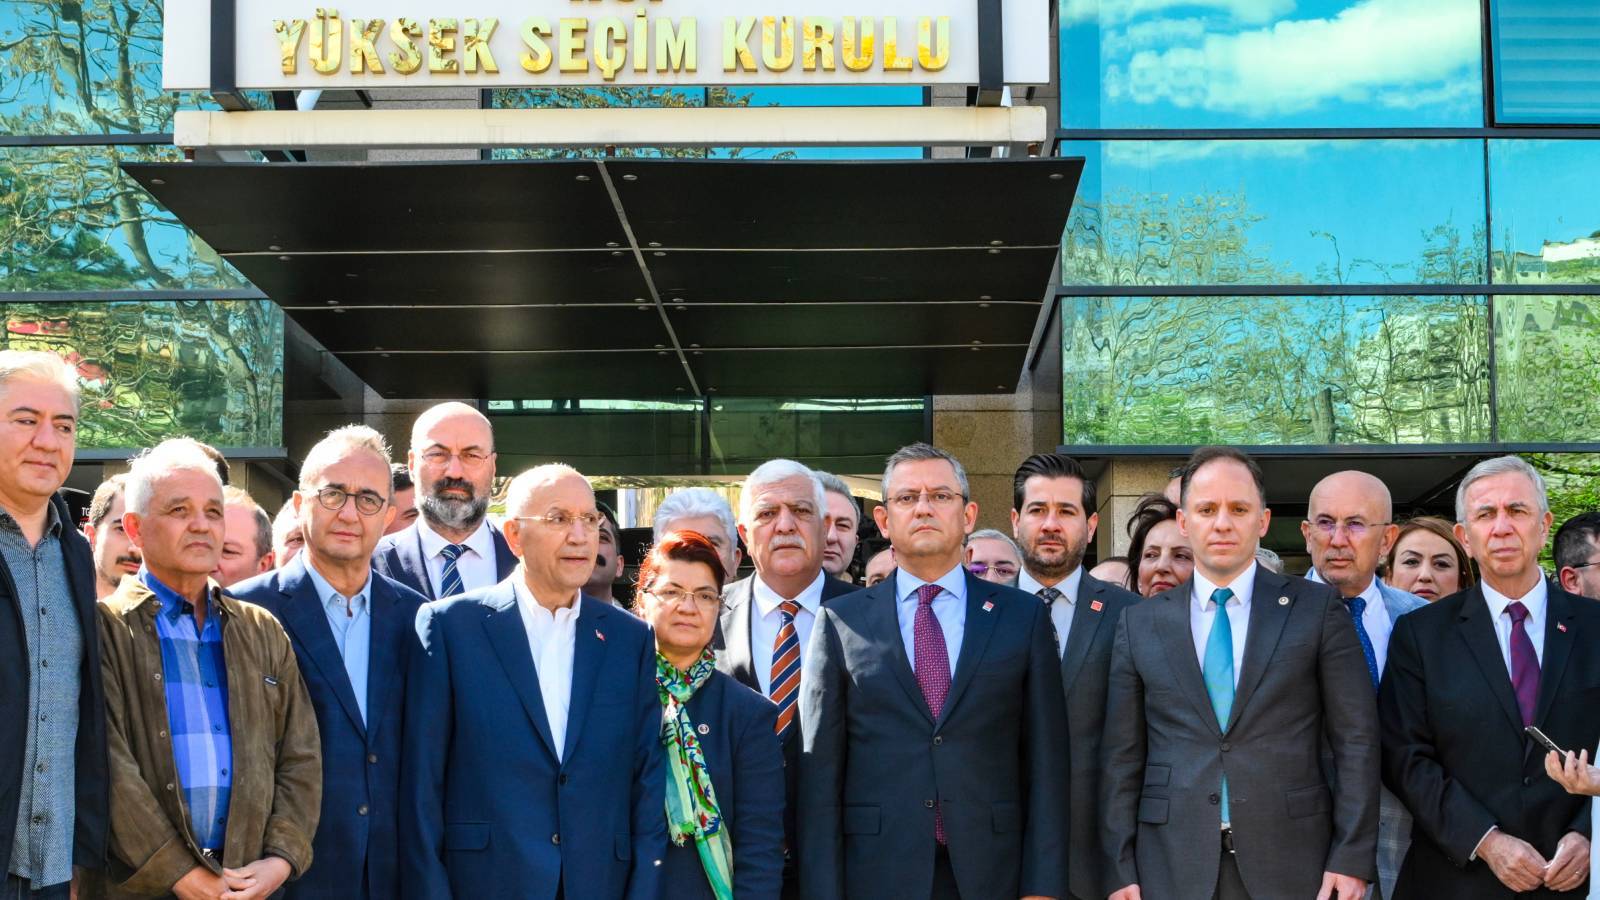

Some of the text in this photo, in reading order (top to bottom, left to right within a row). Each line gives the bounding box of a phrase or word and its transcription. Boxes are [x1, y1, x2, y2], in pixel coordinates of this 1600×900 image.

[272, 8, 950, 81] YÜKSEK SEÇİM KURULU
